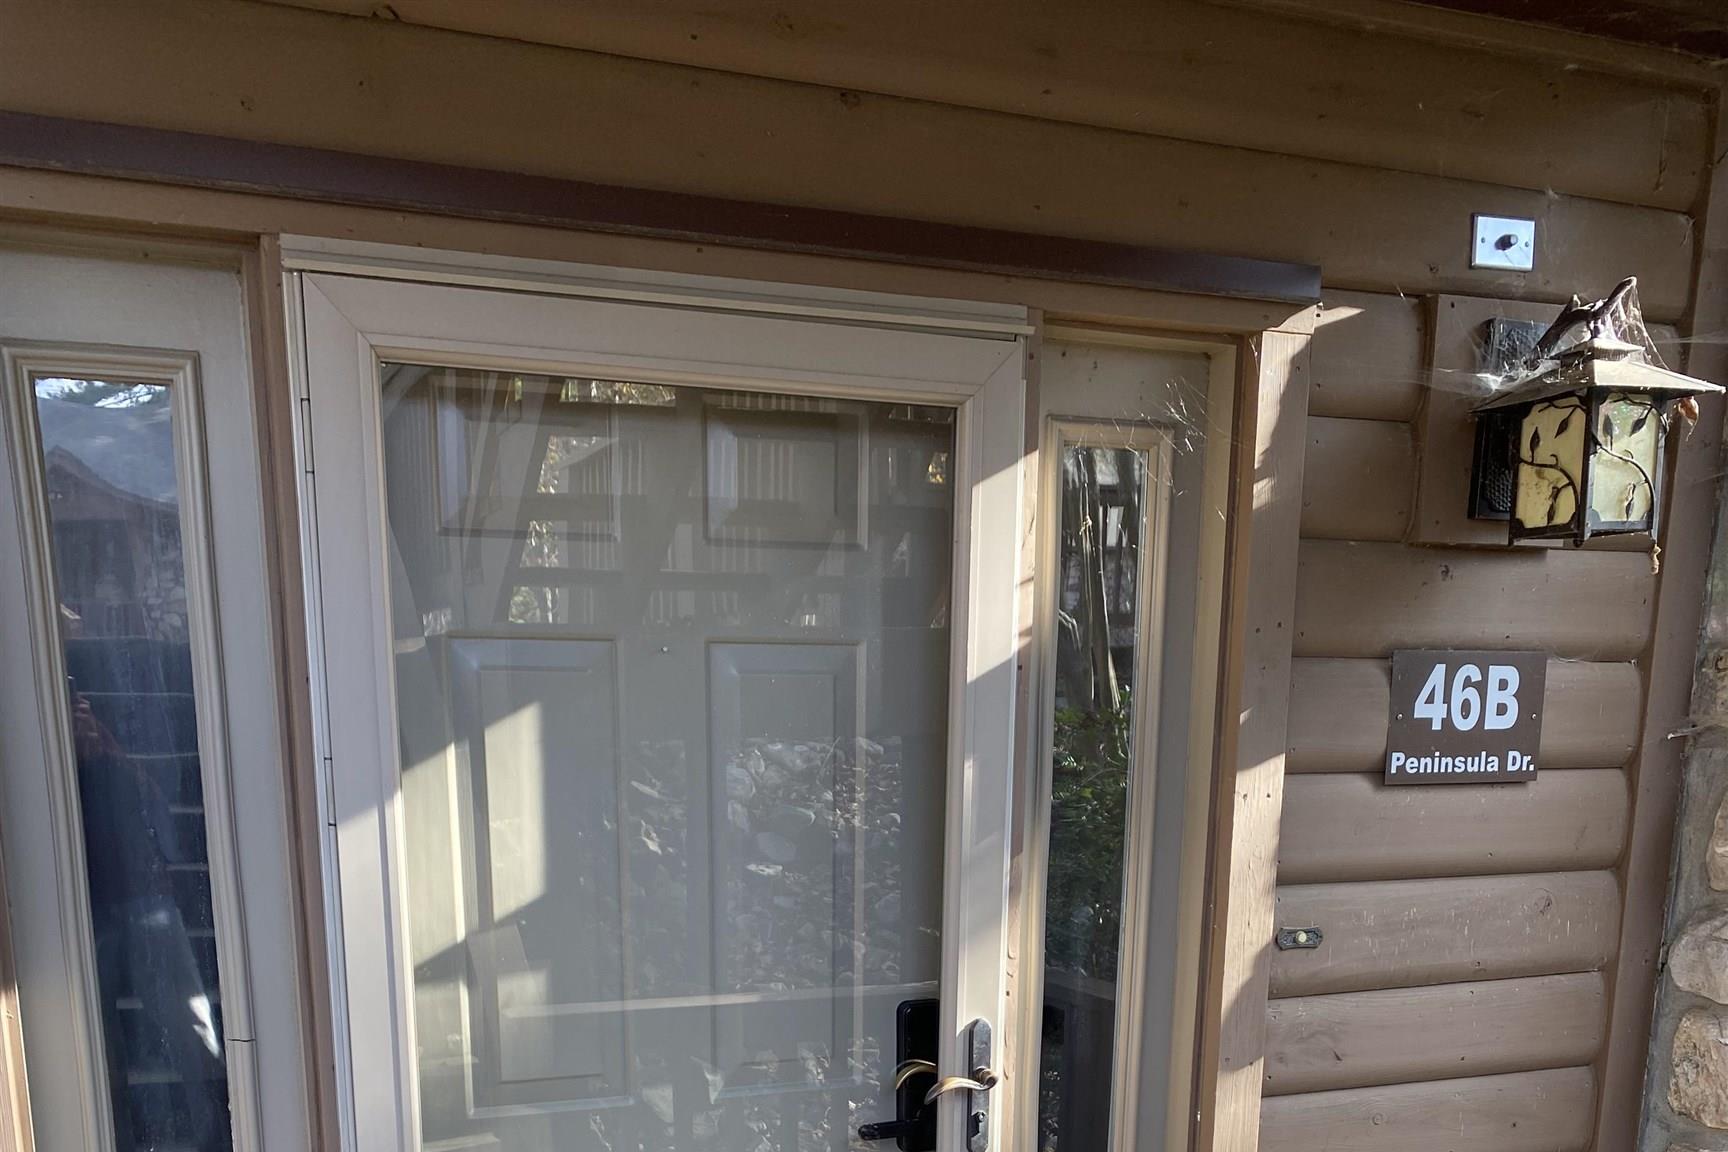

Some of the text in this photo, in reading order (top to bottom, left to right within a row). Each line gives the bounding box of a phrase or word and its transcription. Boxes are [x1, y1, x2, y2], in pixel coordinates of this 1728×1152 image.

[1413, 663, 1520, 731] 46B
[1391, 750, 1535, 774] Peninsula Dr.
